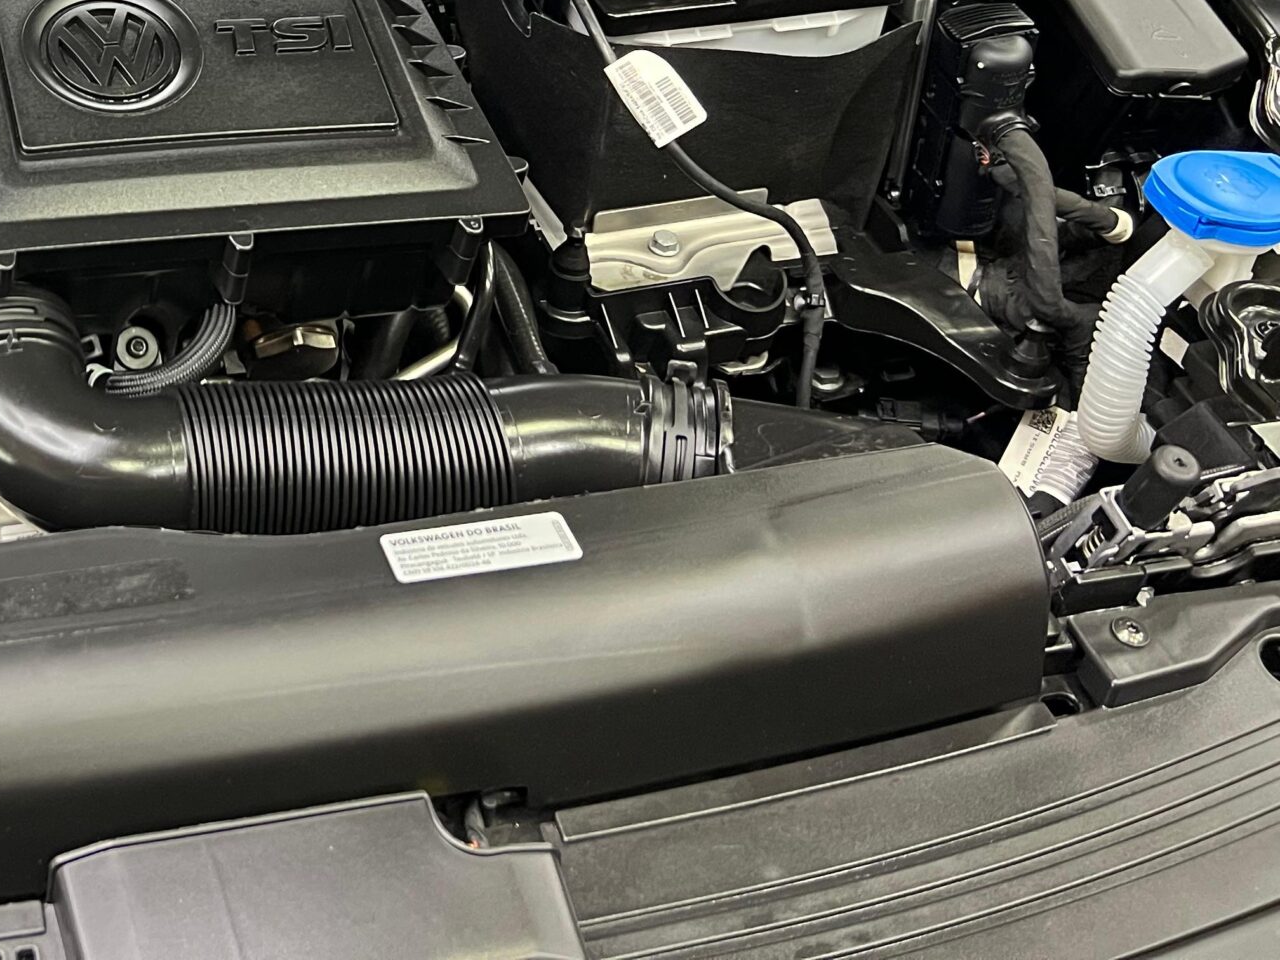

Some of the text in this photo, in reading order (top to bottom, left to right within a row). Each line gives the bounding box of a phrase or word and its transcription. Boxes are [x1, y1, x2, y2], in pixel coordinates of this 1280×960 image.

[46, 2, 177, 94] VW
[214, 14, 354, 56] TSI
[389, 523, 521, 546] VOLKSWAGEN DO BRASIL
